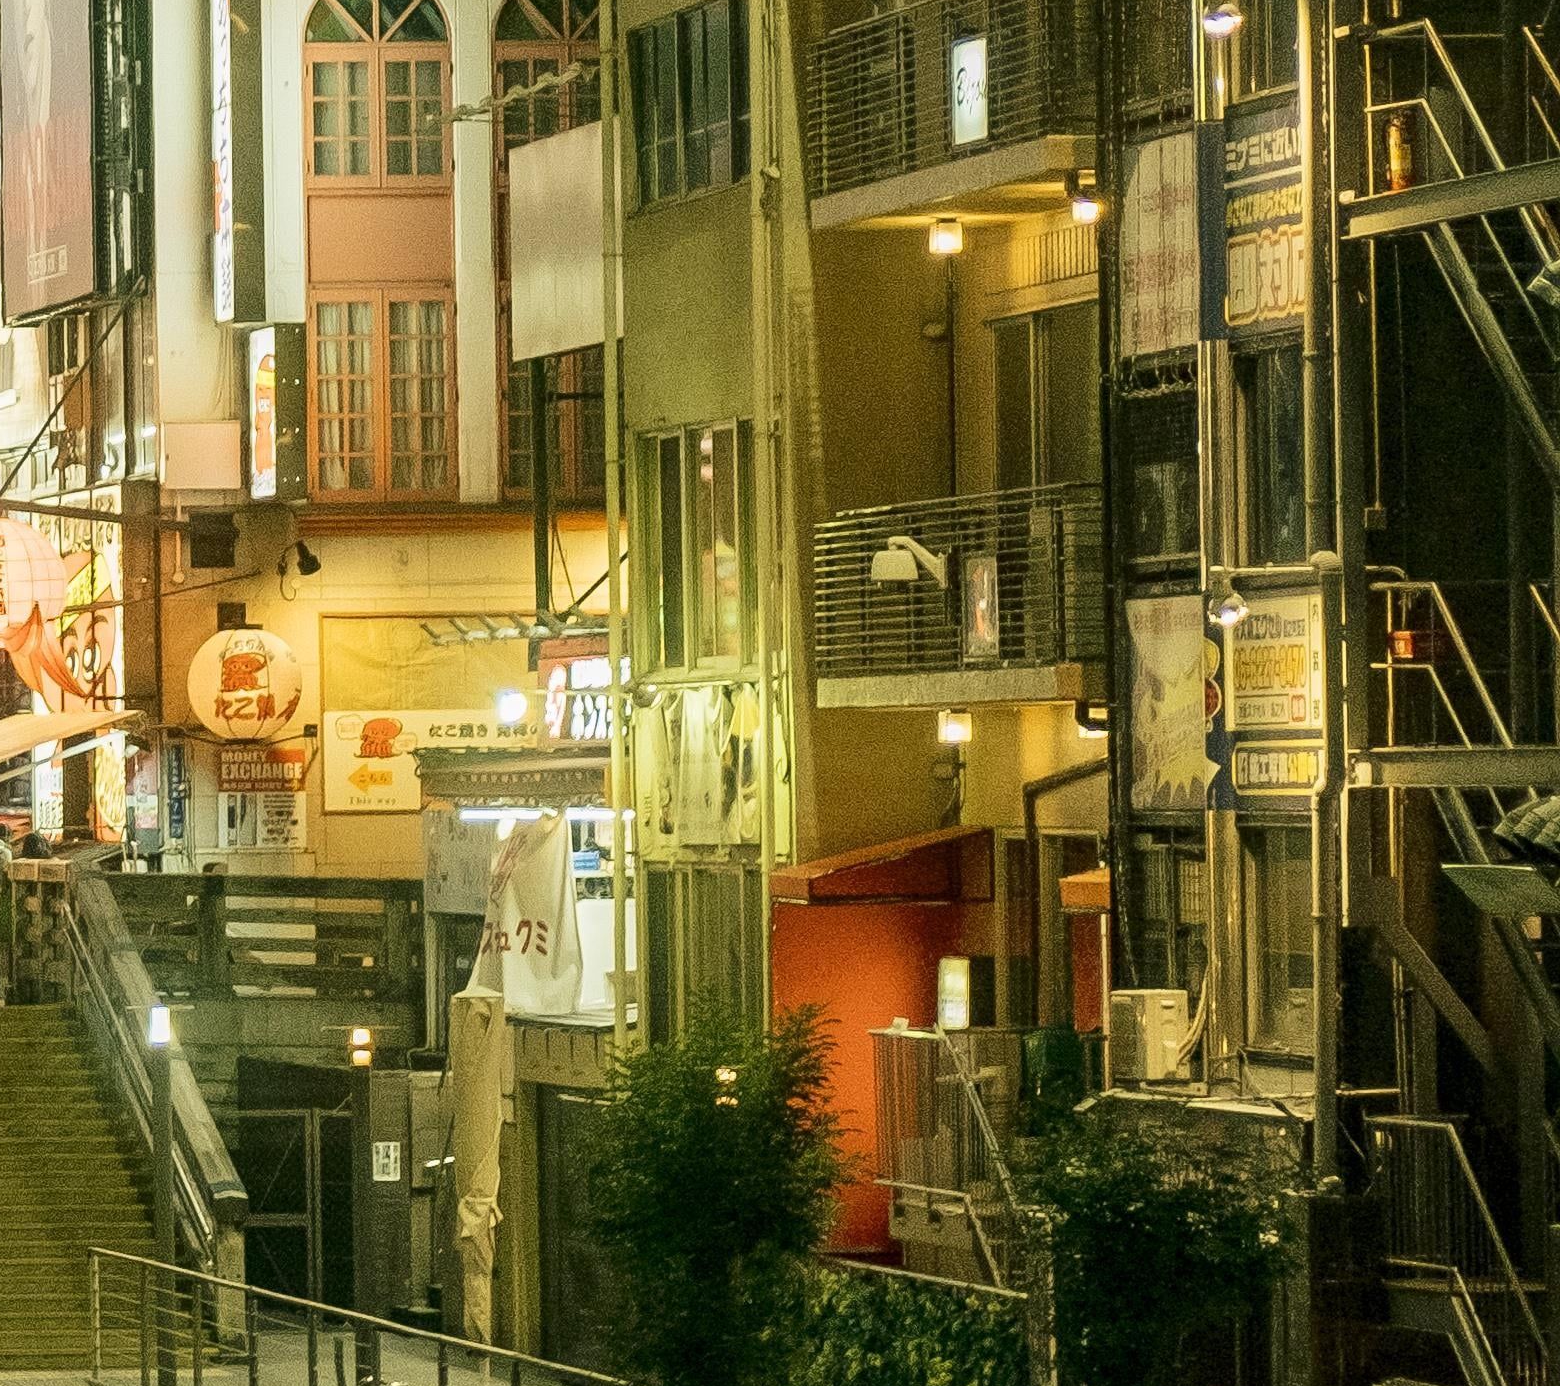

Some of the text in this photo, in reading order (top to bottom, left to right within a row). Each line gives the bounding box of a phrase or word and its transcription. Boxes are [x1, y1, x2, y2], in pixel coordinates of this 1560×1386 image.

[221, 750, 268, 763] MONEY
[221, 762, 304, 780] EXCHANGE
[348, 795, 373, 805] This
